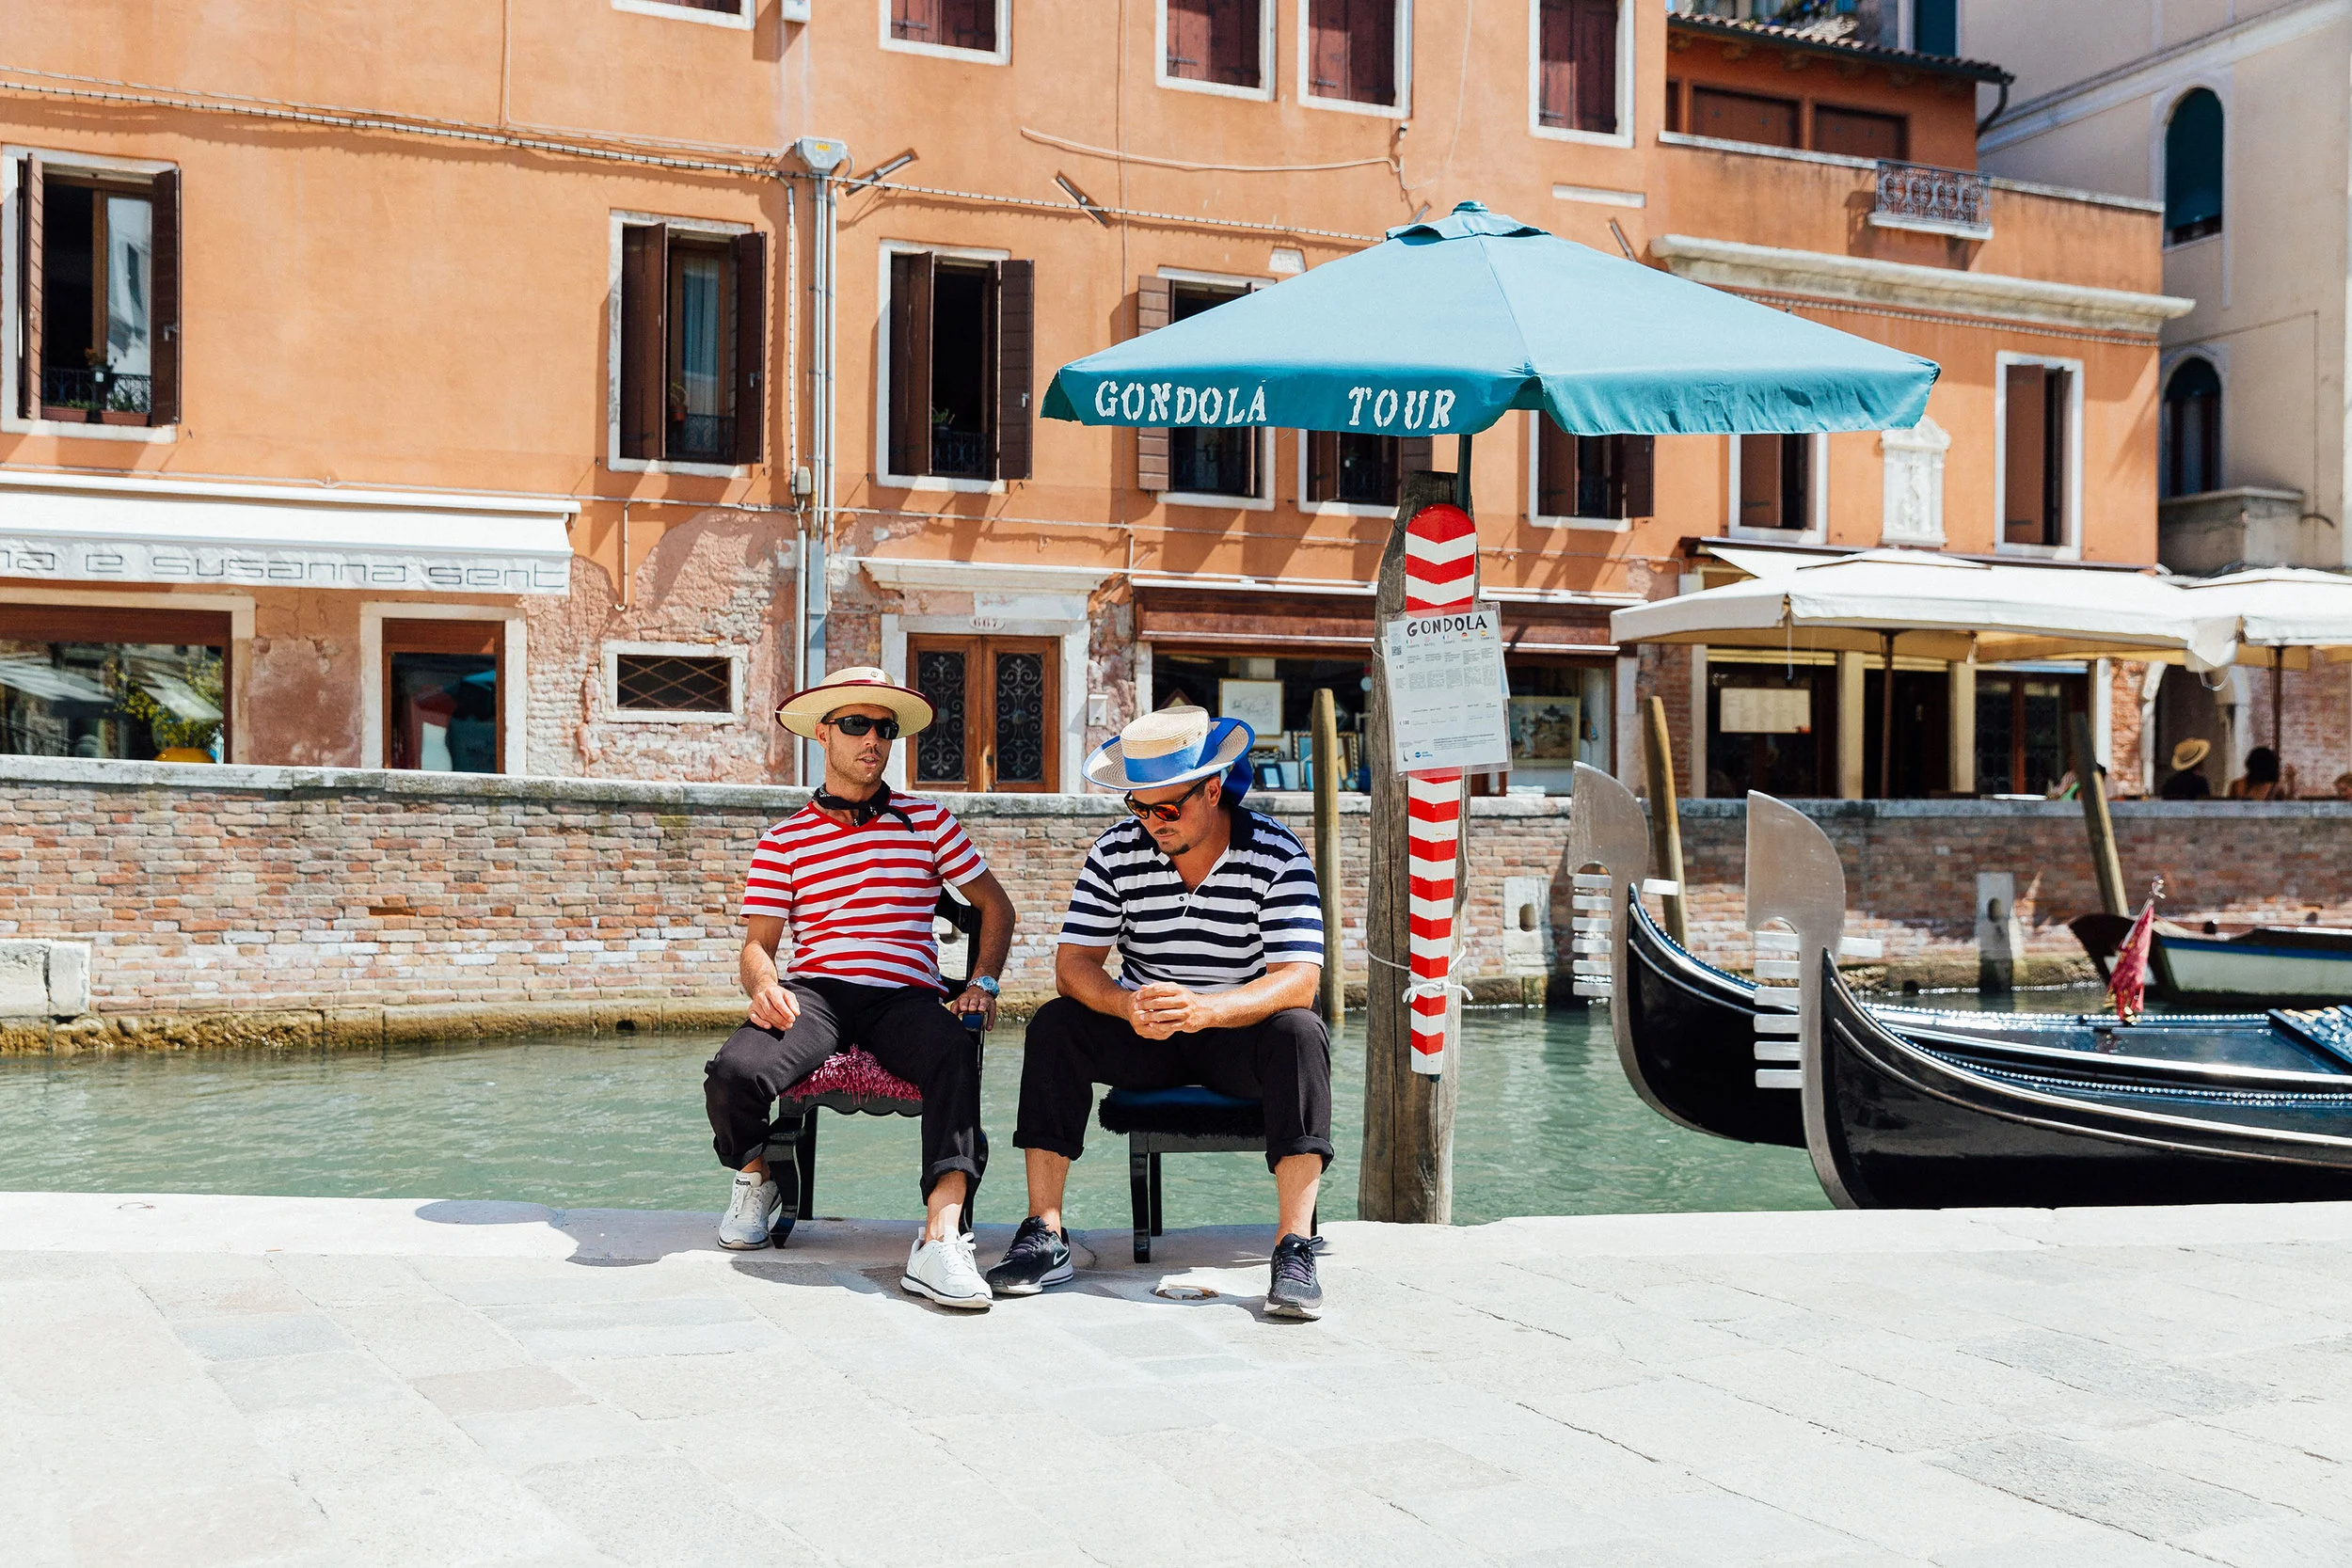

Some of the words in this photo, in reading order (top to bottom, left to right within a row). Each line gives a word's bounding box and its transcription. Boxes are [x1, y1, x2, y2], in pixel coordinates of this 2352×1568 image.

[1094, 378, 1267, 425] GONDOLA
[1347, 385, 1456, 430] TOUR
[86, 554, 123, 573] e
[153, 556, 406, 583] susanna
[429, 566, 565, 589] sent
[973, 617, 999, 628] 667
[1406, 614, 1488, 637] GONDOLA
